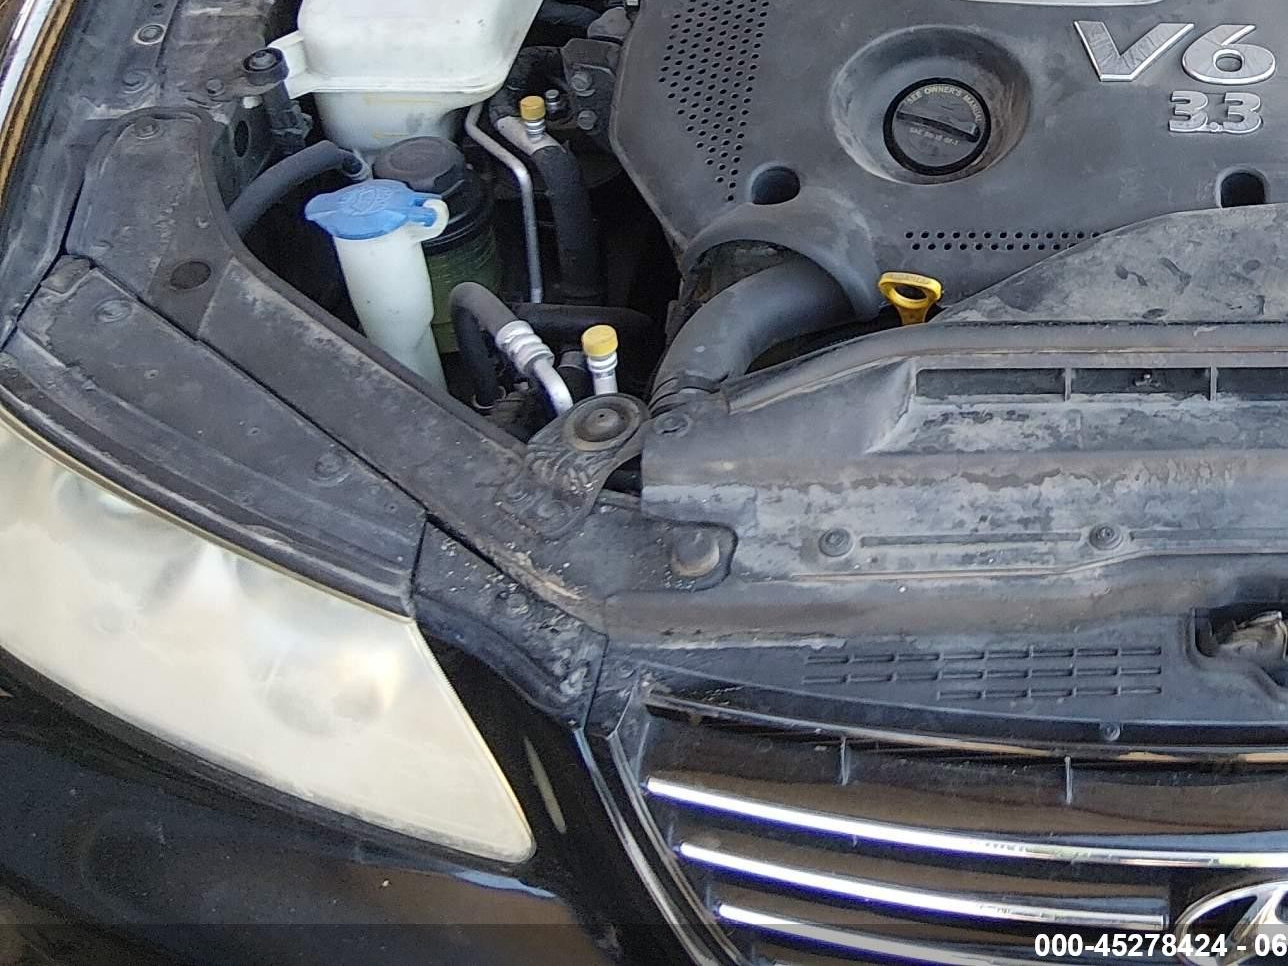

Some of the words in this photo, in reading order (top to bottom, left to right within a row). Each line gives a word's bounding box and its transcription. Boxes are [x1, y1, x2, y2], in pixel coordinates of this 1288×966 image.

[1073, 20, 1276, 85] V6
[907, 91, 922, 104] SEE
[924, 85, 962, 96] OWNER'S
[1167, 90, 1264, 134] 3.3
